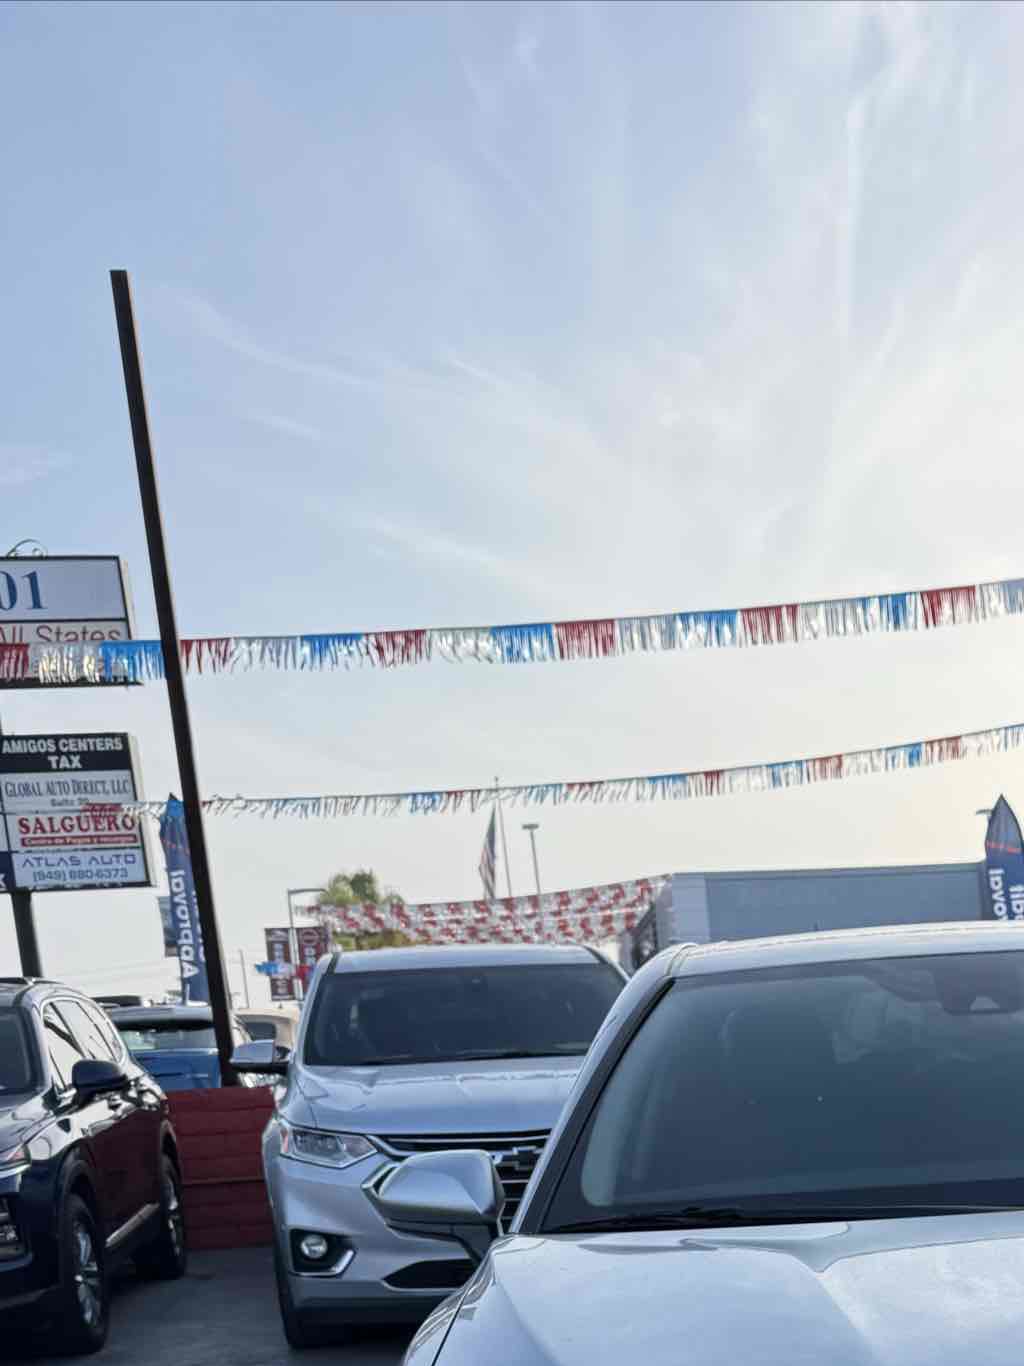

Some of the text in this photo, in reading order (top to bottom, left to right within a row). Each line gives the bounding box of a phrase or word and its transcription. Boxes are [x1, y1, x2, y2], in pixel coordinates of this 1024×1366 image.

[2, 737, 123, 754] AMIGOS CENTERS
[48, 755, 82, 769] TAX
[5, 781, 43, 798] GLOBAL
[46, 780, 69, 796] AUTO
[111, 778, 130, 795] LLC
[18, 813, 136, 835] SALGUERO
[22, 854, 136, 868] ATLAS AUTO
